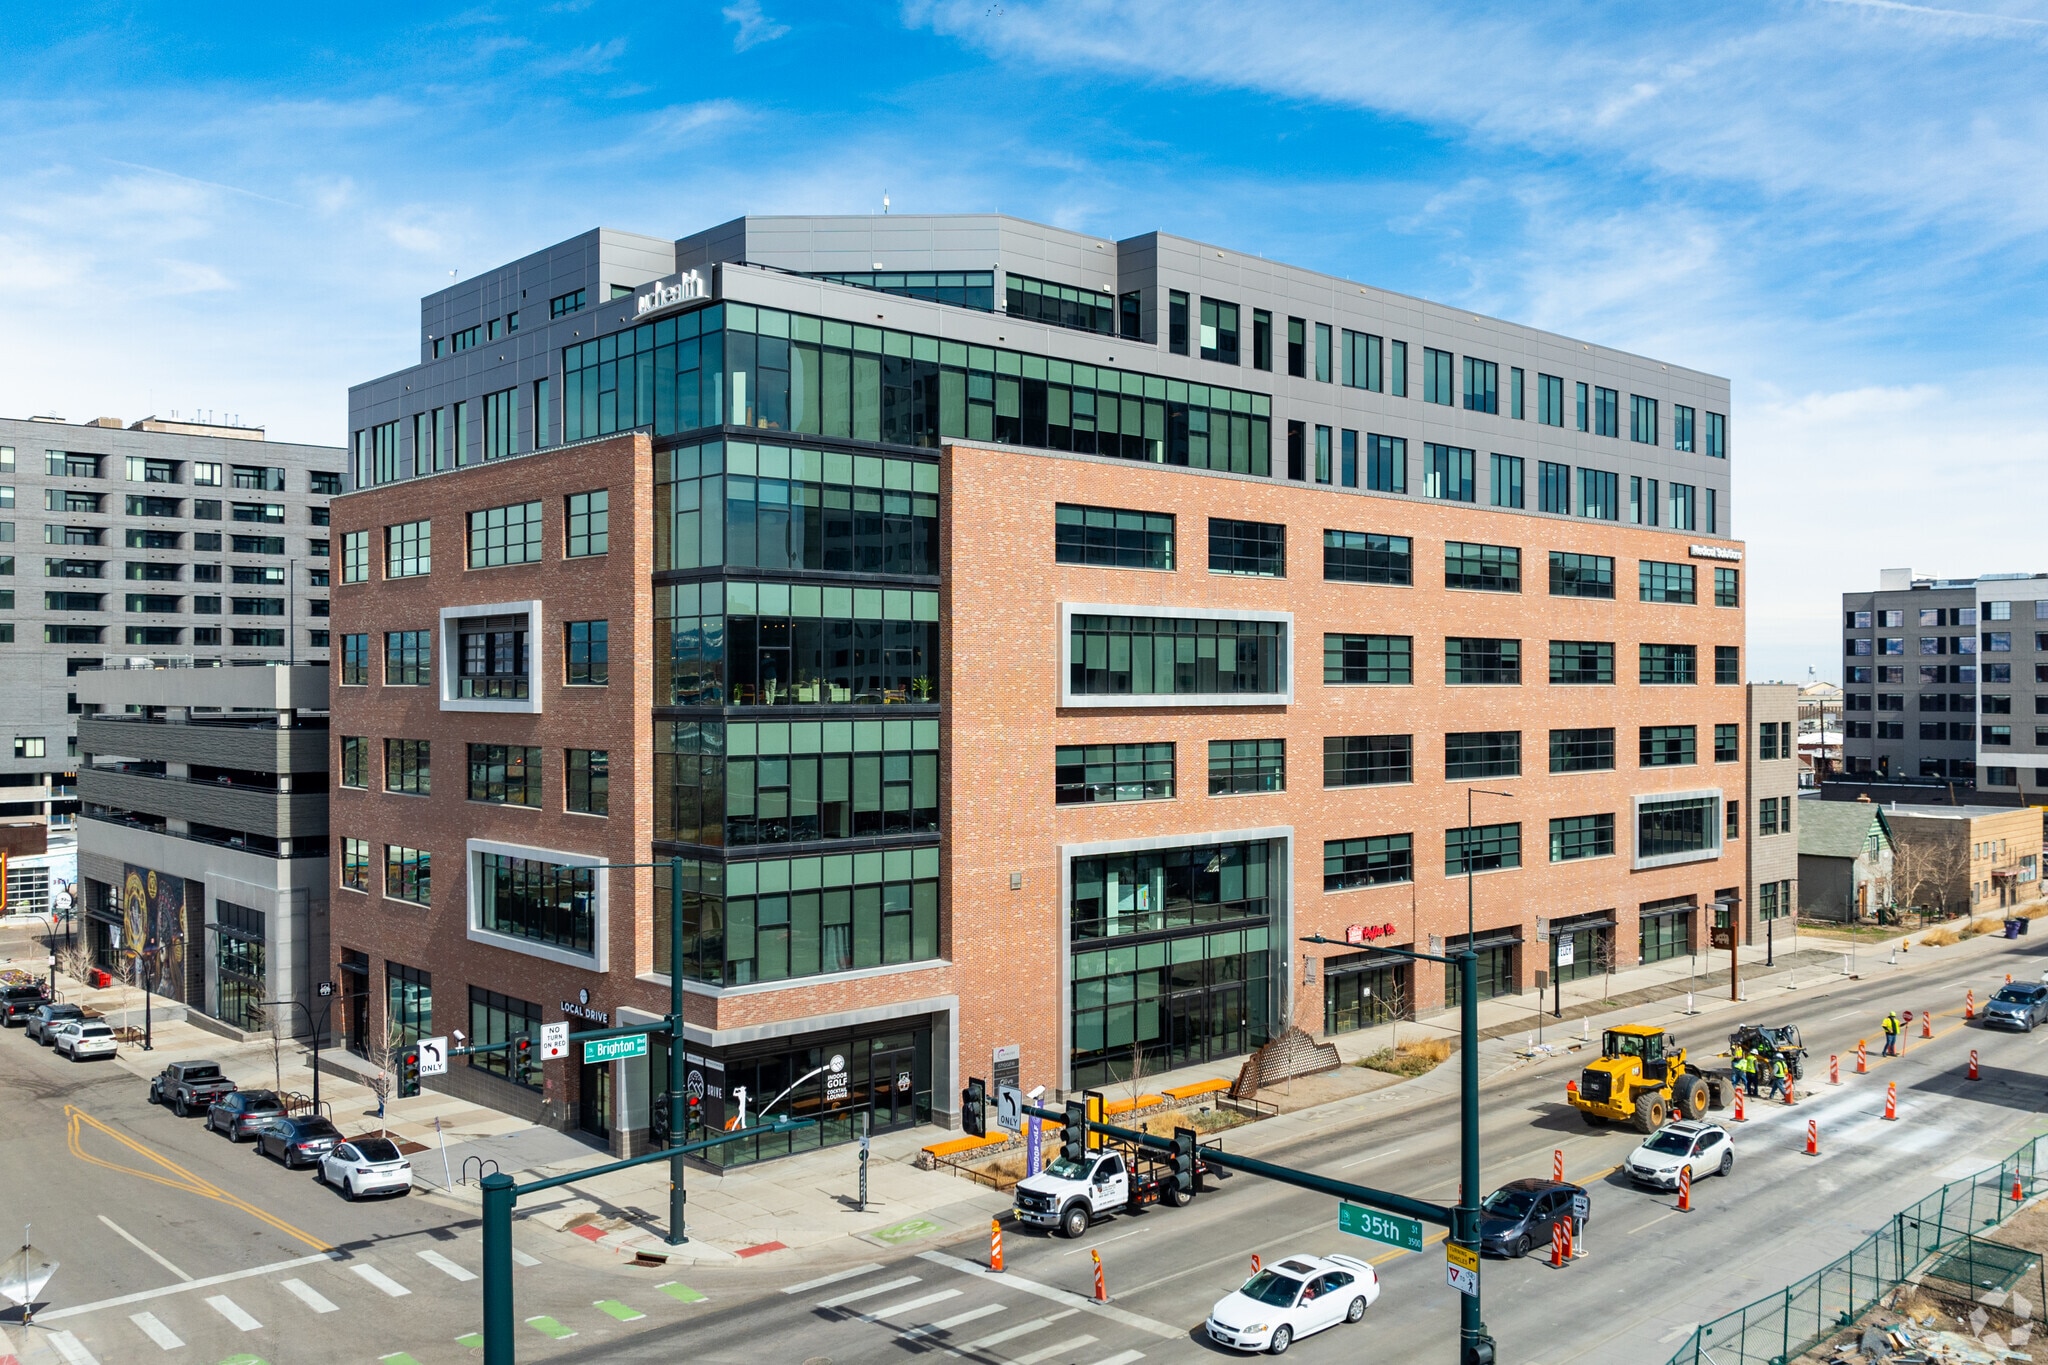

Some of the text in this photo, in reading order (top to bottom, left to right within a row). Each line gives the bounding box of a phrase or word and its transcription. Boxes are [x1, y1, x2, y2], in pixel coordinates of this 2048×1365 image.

[561, 1001, 608, 1024] LOCAL DRIVE
[549, 1026, 560, 1034] NO
[597, 1041, 635, 1057] Brighton
[421, 1063, 443, 1073] ONLY
[827, 1071, 848, 1081] INDOOR
[827, 1077, 848, 1088] GOLF
[707, 1084, 722, 1099] DRIVE
[1000, 1115, 1018, 1127] ONLY
[1574, 1209, 1587, 1217] RIGHT
[1361, 1213, 1418, 1241] 35th St
[1407, 1237, 1421, 1249] 3500
[1449, 1245, 1468, 1258] TURNING
[1448, 1254, 1468, 1266] VEHICLES
